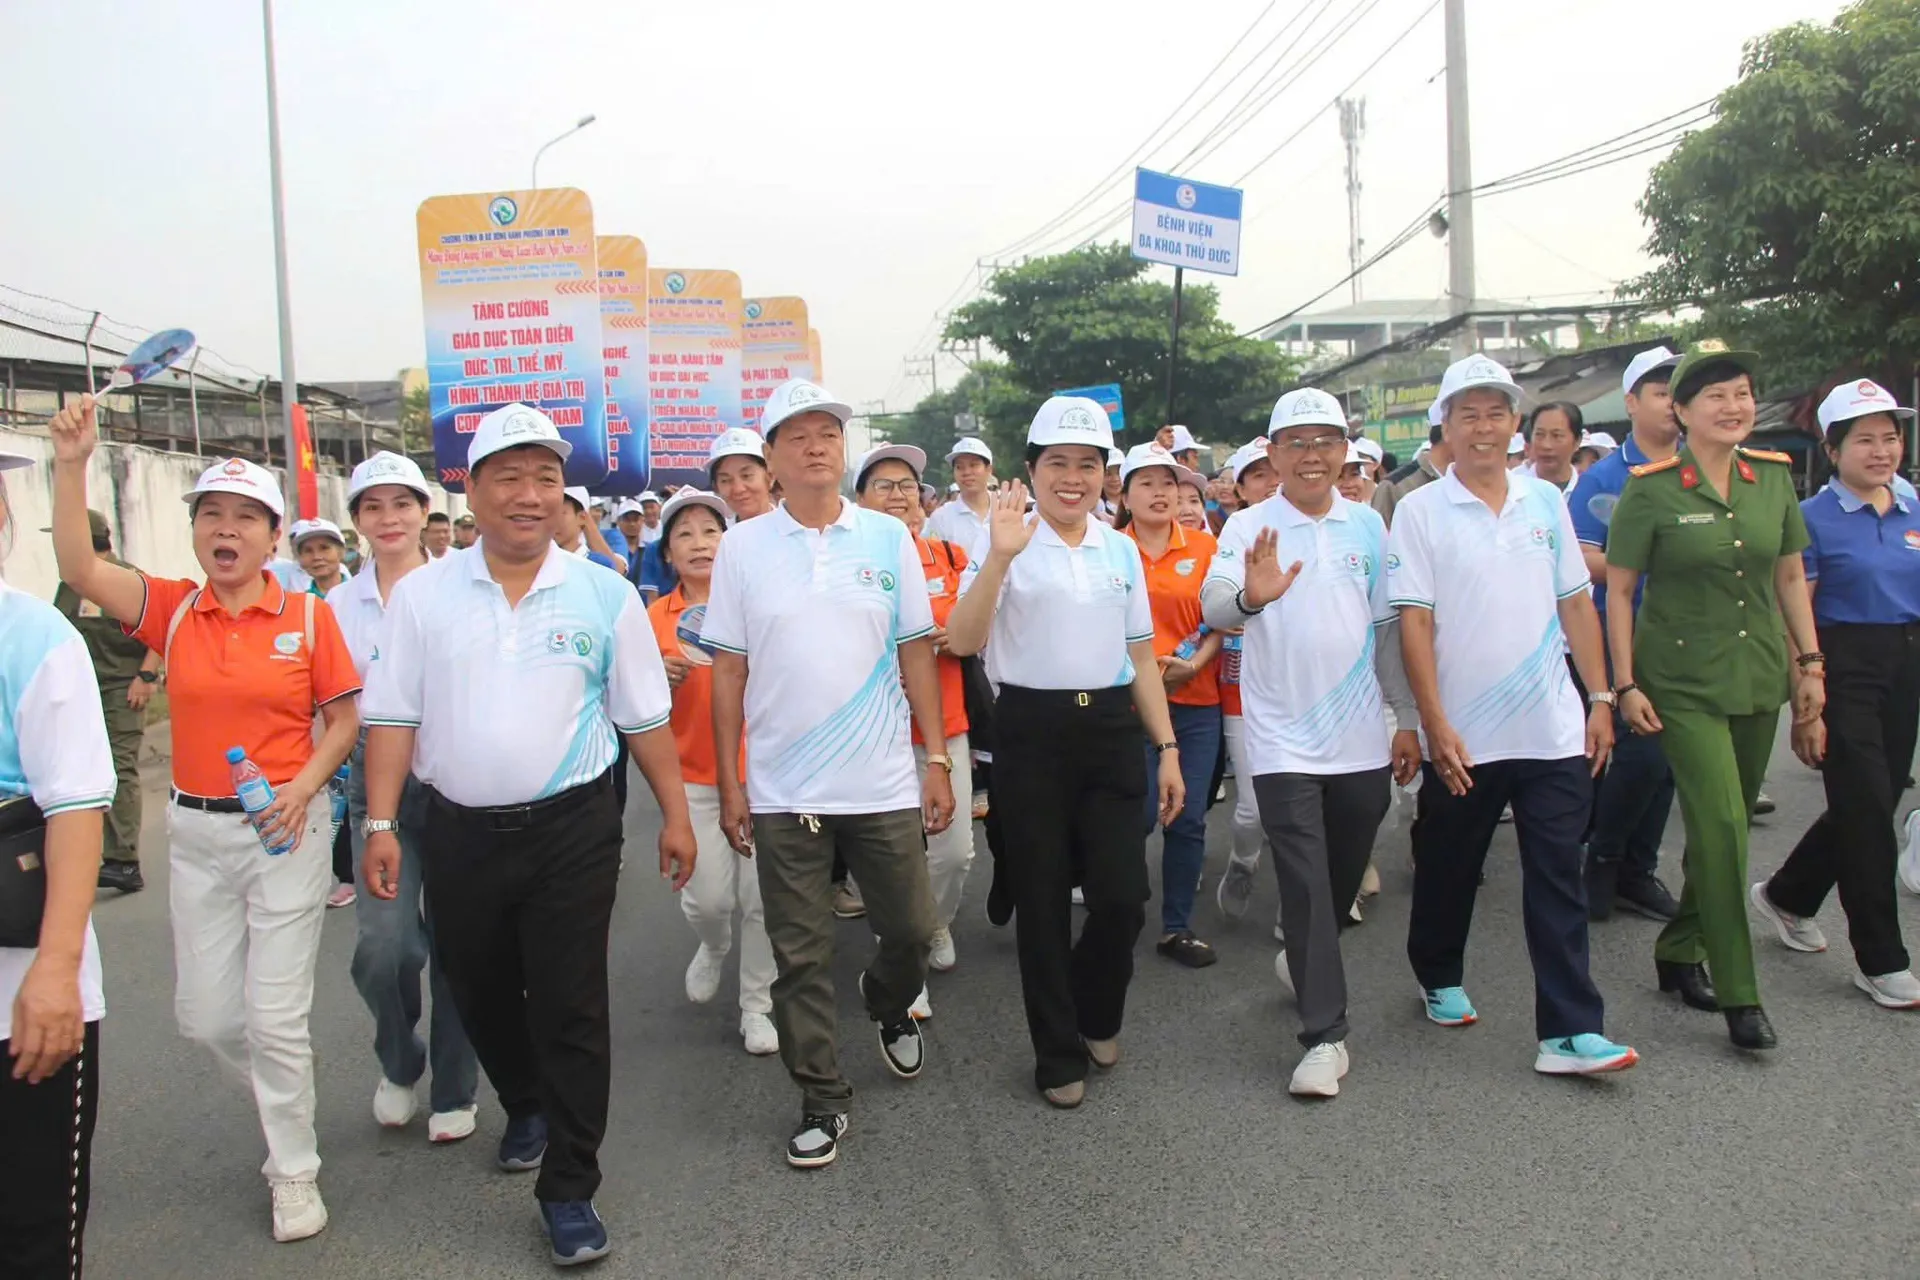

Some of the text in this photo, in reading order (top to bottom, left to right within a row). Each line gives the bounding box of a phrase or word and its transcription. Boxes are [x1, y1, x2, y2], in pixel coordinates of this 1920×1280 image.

[1157, 212, 1213, 239] BỆNH VIỆN
[1154, 237, 1181, 256] KHOA
[1185, 241, 1205, 260] THỦ
[473, 298, 549, 321] TĂNG CƯỜNG
[452, 324, 574, 350] GIÁO DỤC TOÀN DIỆN
[450, 384, 479, 405] HÌNH
[484, 382, 522, 402] THÀNH
[525, 380, 540, 404] HỆ
[543, 380, 563, 400] GIÁ
[566, 380, 586, 402] TRỊ
[552, 408, 583, 426] NAM
